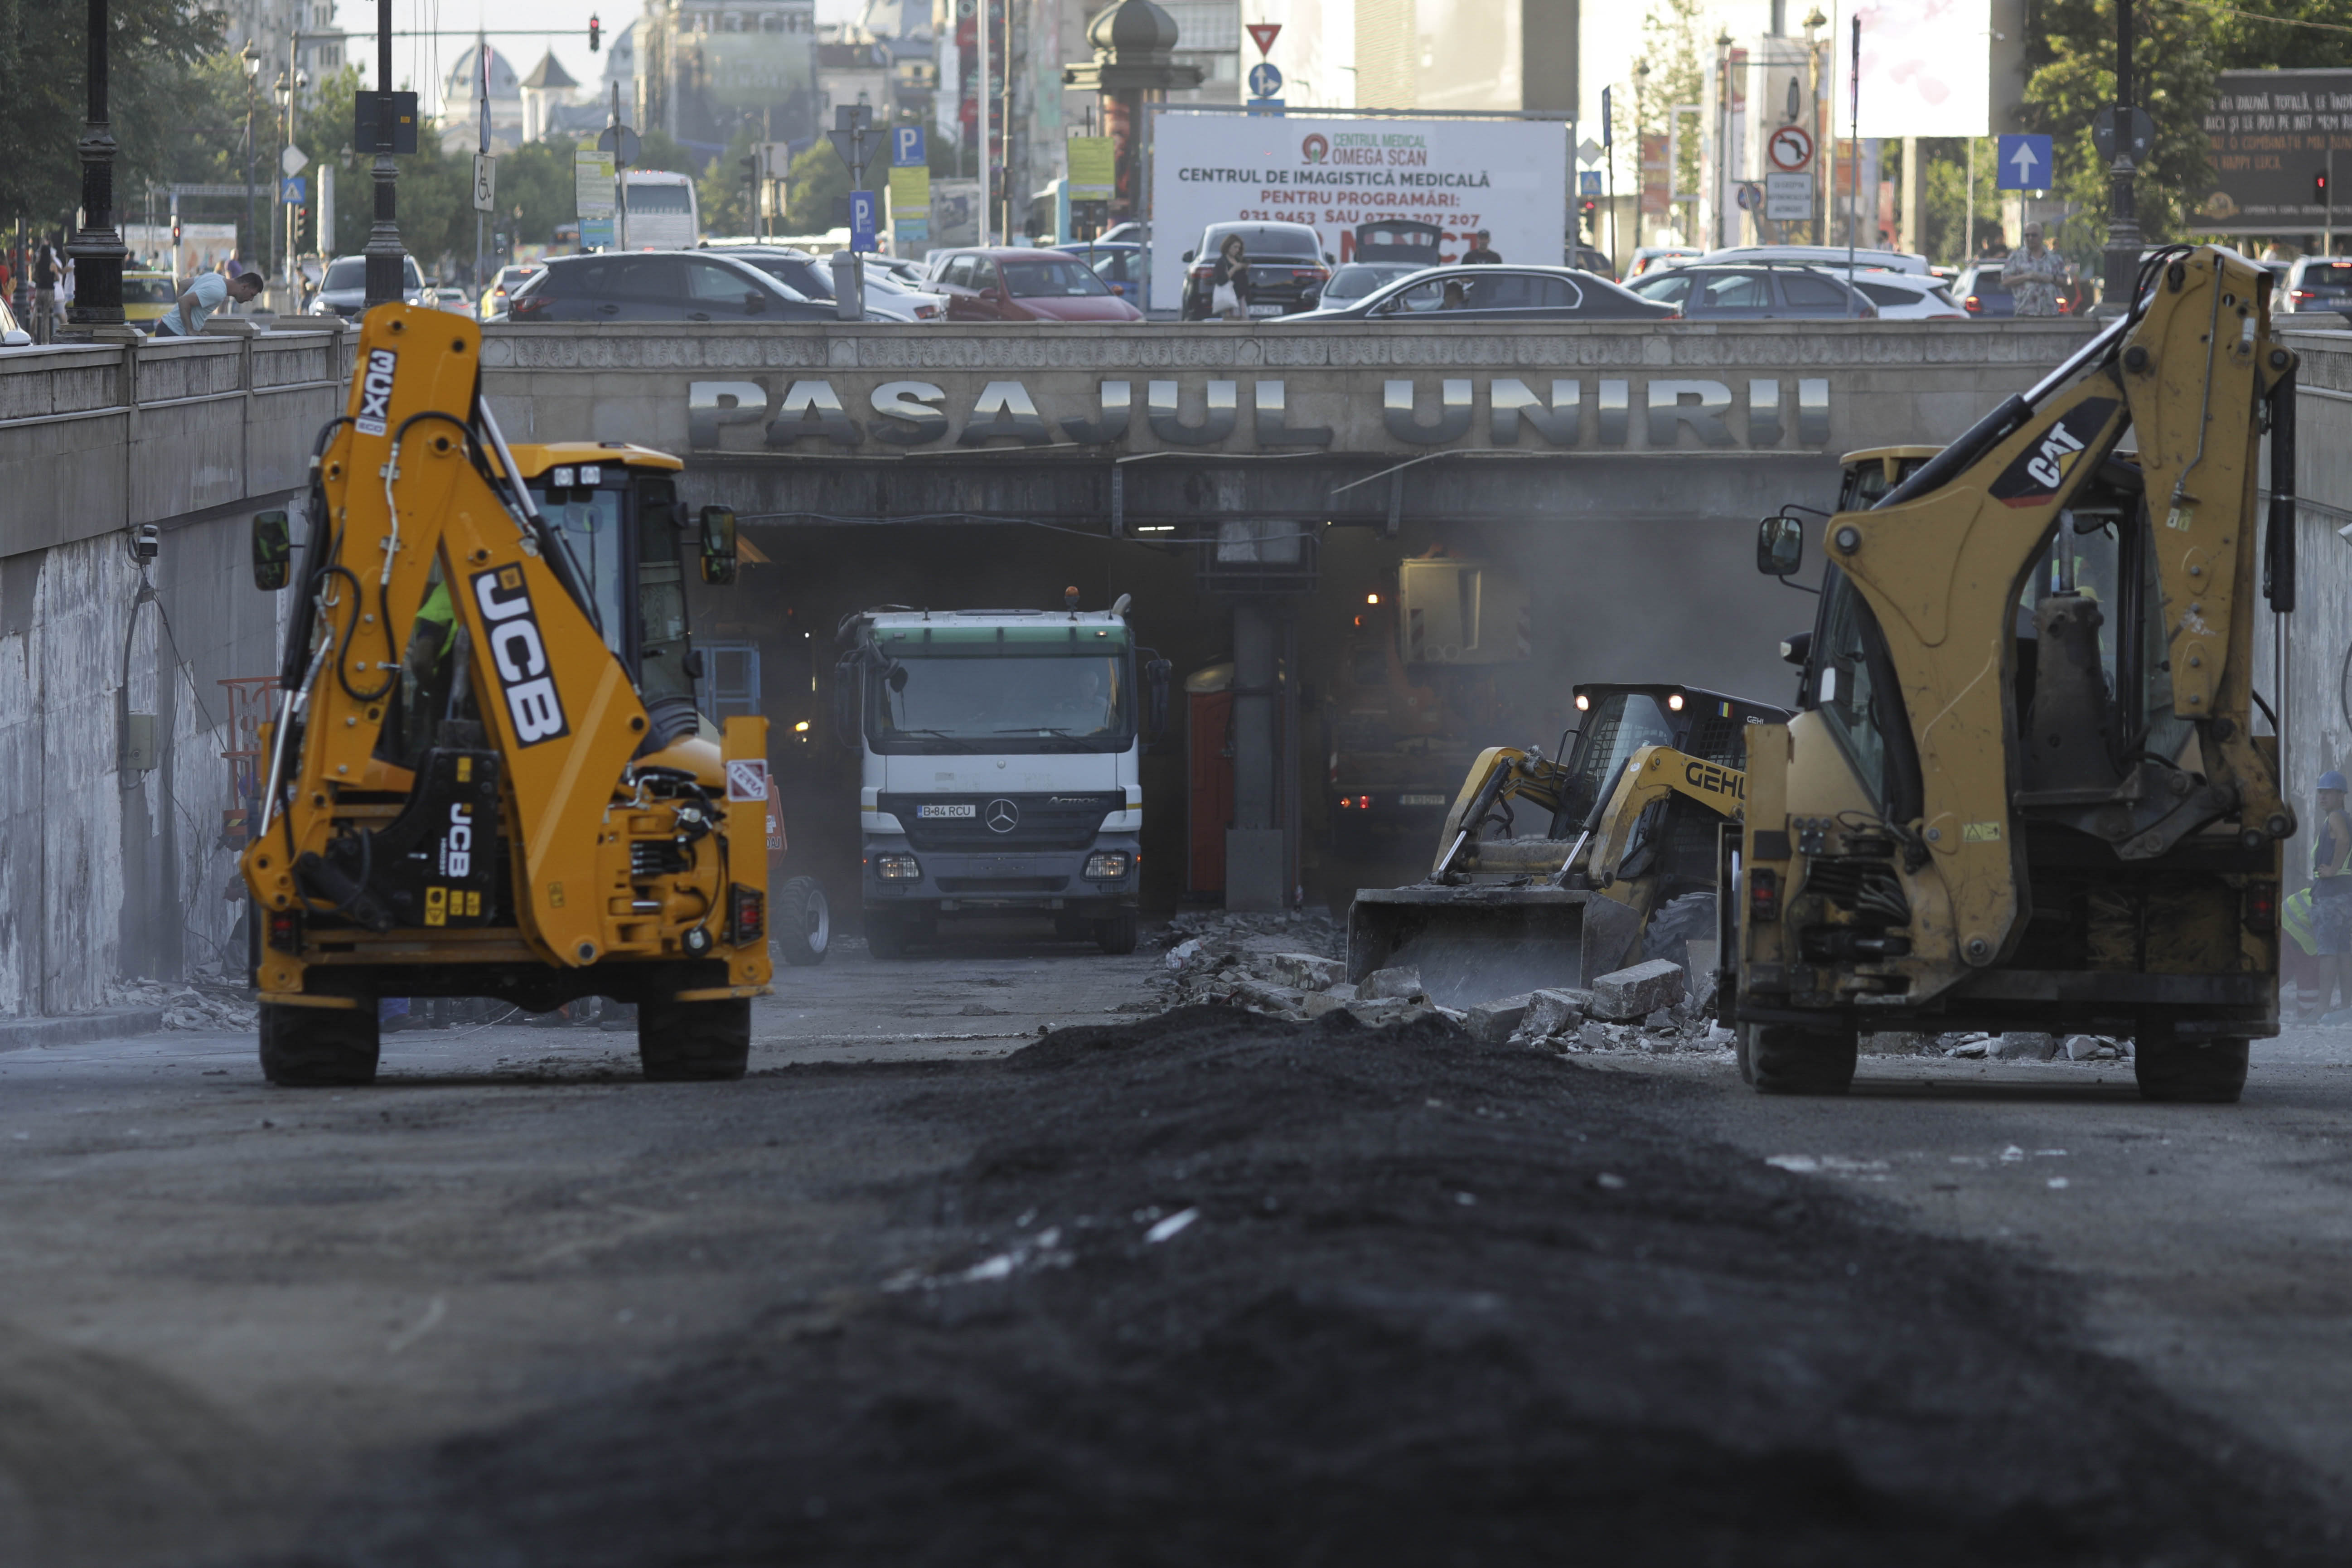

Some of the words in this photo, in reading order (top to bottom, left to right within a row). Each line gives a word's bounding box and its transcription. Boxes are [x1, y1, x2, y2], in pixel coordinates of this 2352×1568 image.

[900, 129, 917, 160] P
[1334, 133, 1379, 147] CENTRUL
[1382, 135, 1427, 148] MEDICAL
[1332, 149, 1384, 165] OMEGA
[1388, 150, 1427, 167] SCAN
[1179, 168, 1261, 184] CENTRUL
[1266, 169, 1289, 184] DE
[1294, 169, 1395, 186] IMAGISTICĂ
[1400, 170, 1490, 188] MEDICALĂ
[1261, 190, 1334, 205] PENTRU
[1338, 189, 1460, 208] PROGRAMĂRI:
[855, 199, 869, 232] P
[1240, 210, 1270, 221] 031
[1275, 211, 1315, 225] 9453
[1325, 209, 1359, 223] SAU
[1449, 214, 1481, 227] 207
[361, 350, 395, 417] 3CX
[688, 380, 1334, 446] PASAJUL
[1383, 379, 1830, 446] UNIRII
[359, 423, 383, 433] ECO
[2027, 422, 2085, 488] CAT
[476, 573, 563, 742] JCB
[733, 765, 763, 795] TERRA
[923, 806, 930, 816] B
[934, 806, 946, 816] 84
[949, 806, 971, 817] RCU
[448, 803, 471, 877] JCB
